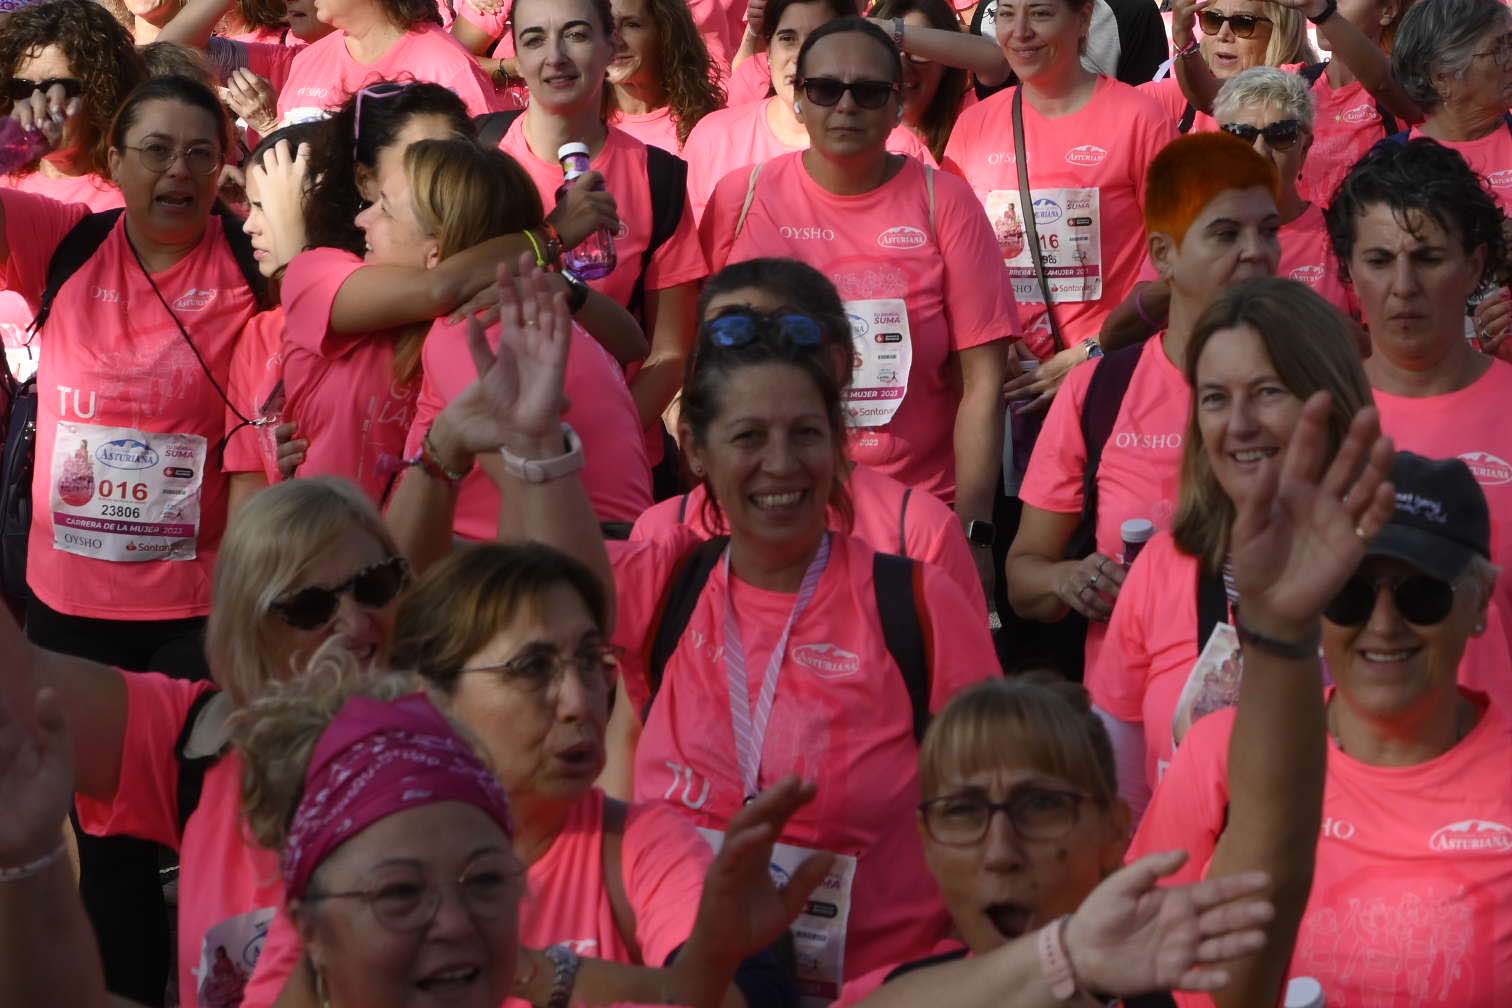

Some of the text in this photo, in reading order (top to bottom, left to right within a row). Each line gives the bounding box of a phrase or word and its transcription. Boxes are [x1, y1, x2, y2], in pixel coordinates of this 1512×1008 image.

[779, 226, 835, 241] OYSHO
[1039, 234, 1060, 250] 16
[57, 384, 98, 419] TU
[1115, 431, 1182, 449] OYSHO
[101, 447, 154, 465] ASTURIANA
[98, 479, 150, 502] 016
[101, 504, 140, 519] 23806
[65, 517, 102, 530] CARRERA
[103, 522, 115, 531] DE
[117, 524, 128, 532] LA
[64, 533, 103, 550] OYSHO
[664, 761, 709, 809] TU
[1438, 834, 1509, 850] ASTURIANA
